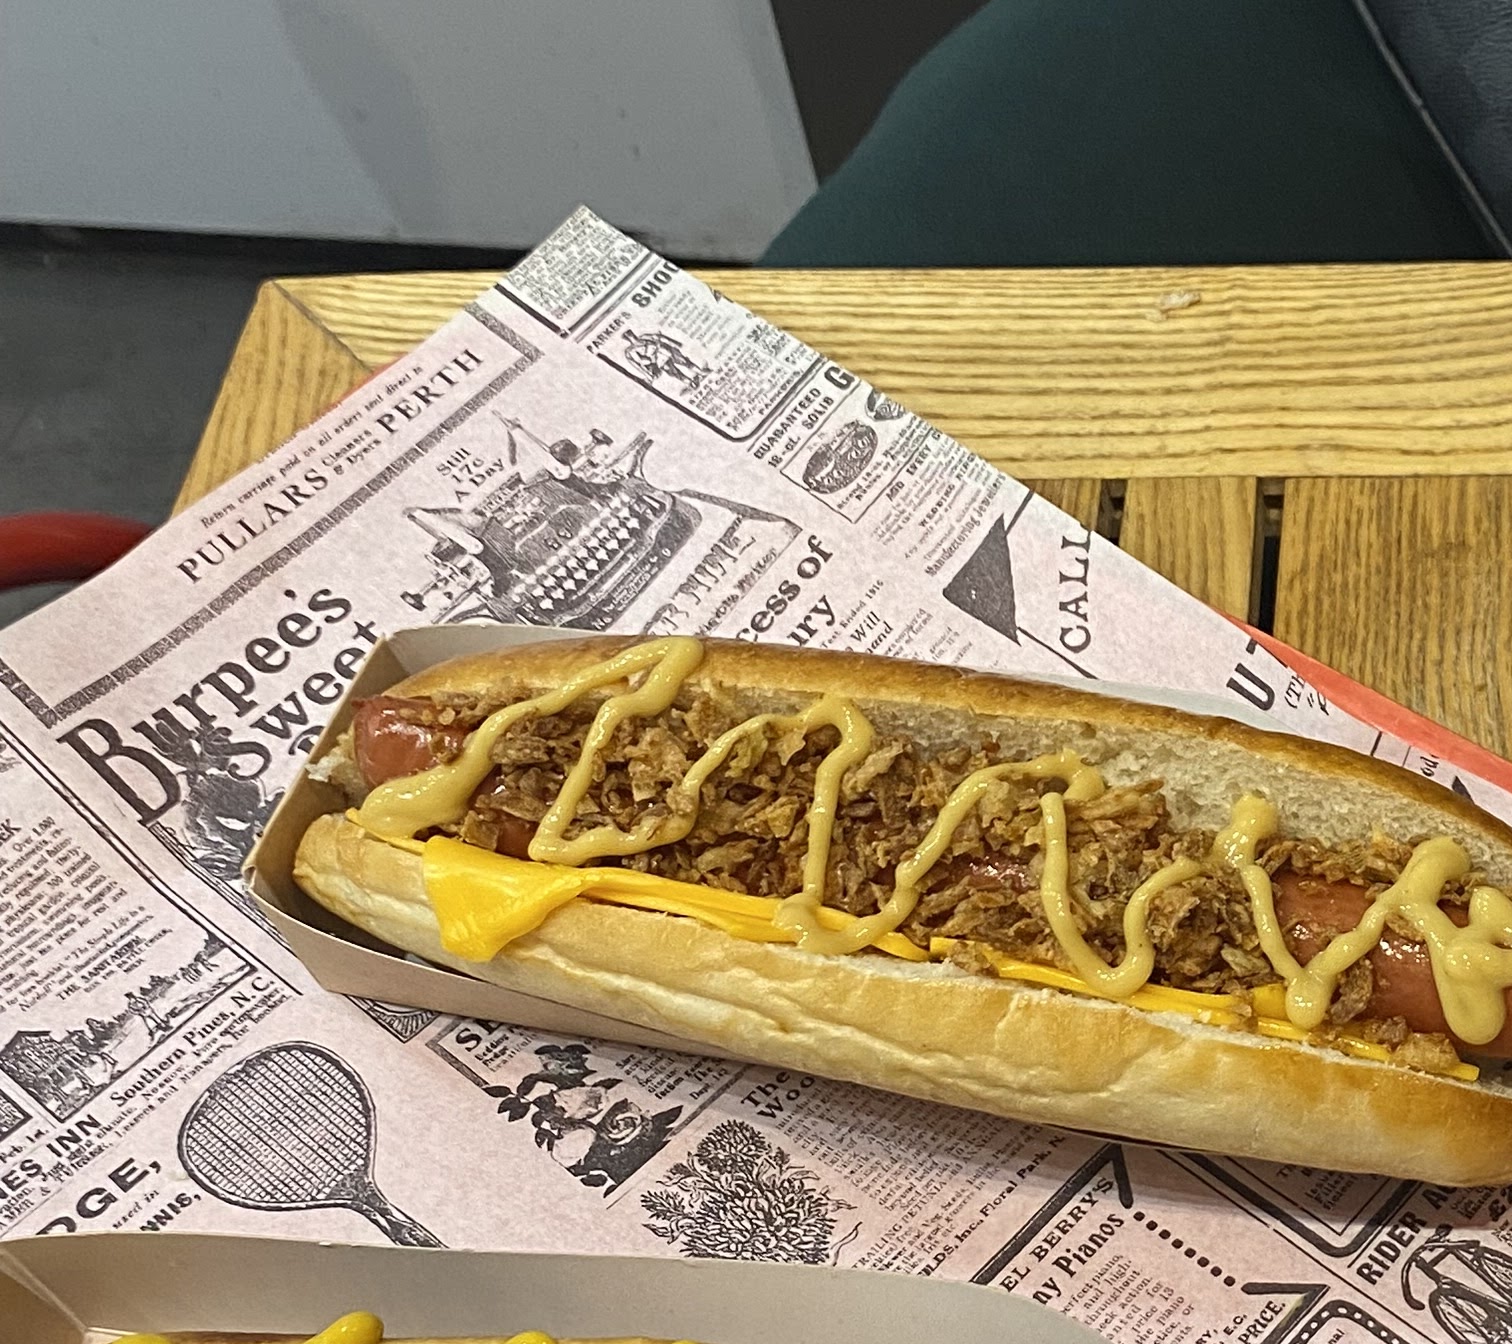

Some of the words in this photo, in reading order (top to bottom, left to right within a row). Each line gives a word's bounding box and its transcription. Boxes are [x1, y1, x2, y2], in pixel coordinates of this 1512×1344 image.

[585, 311, 631, 354] PARKER'S
[177, 468, 327, 582] PULLARS
[376, 348, 481, 434] PERTH
[436, 447, 472, 478] Still
[469, 458, 505, 489] Day
[796, 534, 833, 579] of
[848, 610, 881, 642] Will
[56, 589, 352, 824] Burpee's
[45, 1113, 101, 1158] INN
[109, 1047, 186, 1107] Southern
[182, 1010, 236, 1047] Pines,
[741, 1068, 792, 1110] The
[978, 1178, 1018, 1217] Floral
[1031, 1174, 1116, 1264] BERRY'S
[1052, 1213, 1124, 1277] Pianos
[1356, 1205, 1428, 1285] RIDER
[1144, 1280, 1164, 1298] for
[1155, 1290, 1185, 1326] piano
[1180, 1302, 1195, 1316] or
[1130, 1304, 1158, 1336] price
[1222, 1313, 1247, 1336] E.C.
